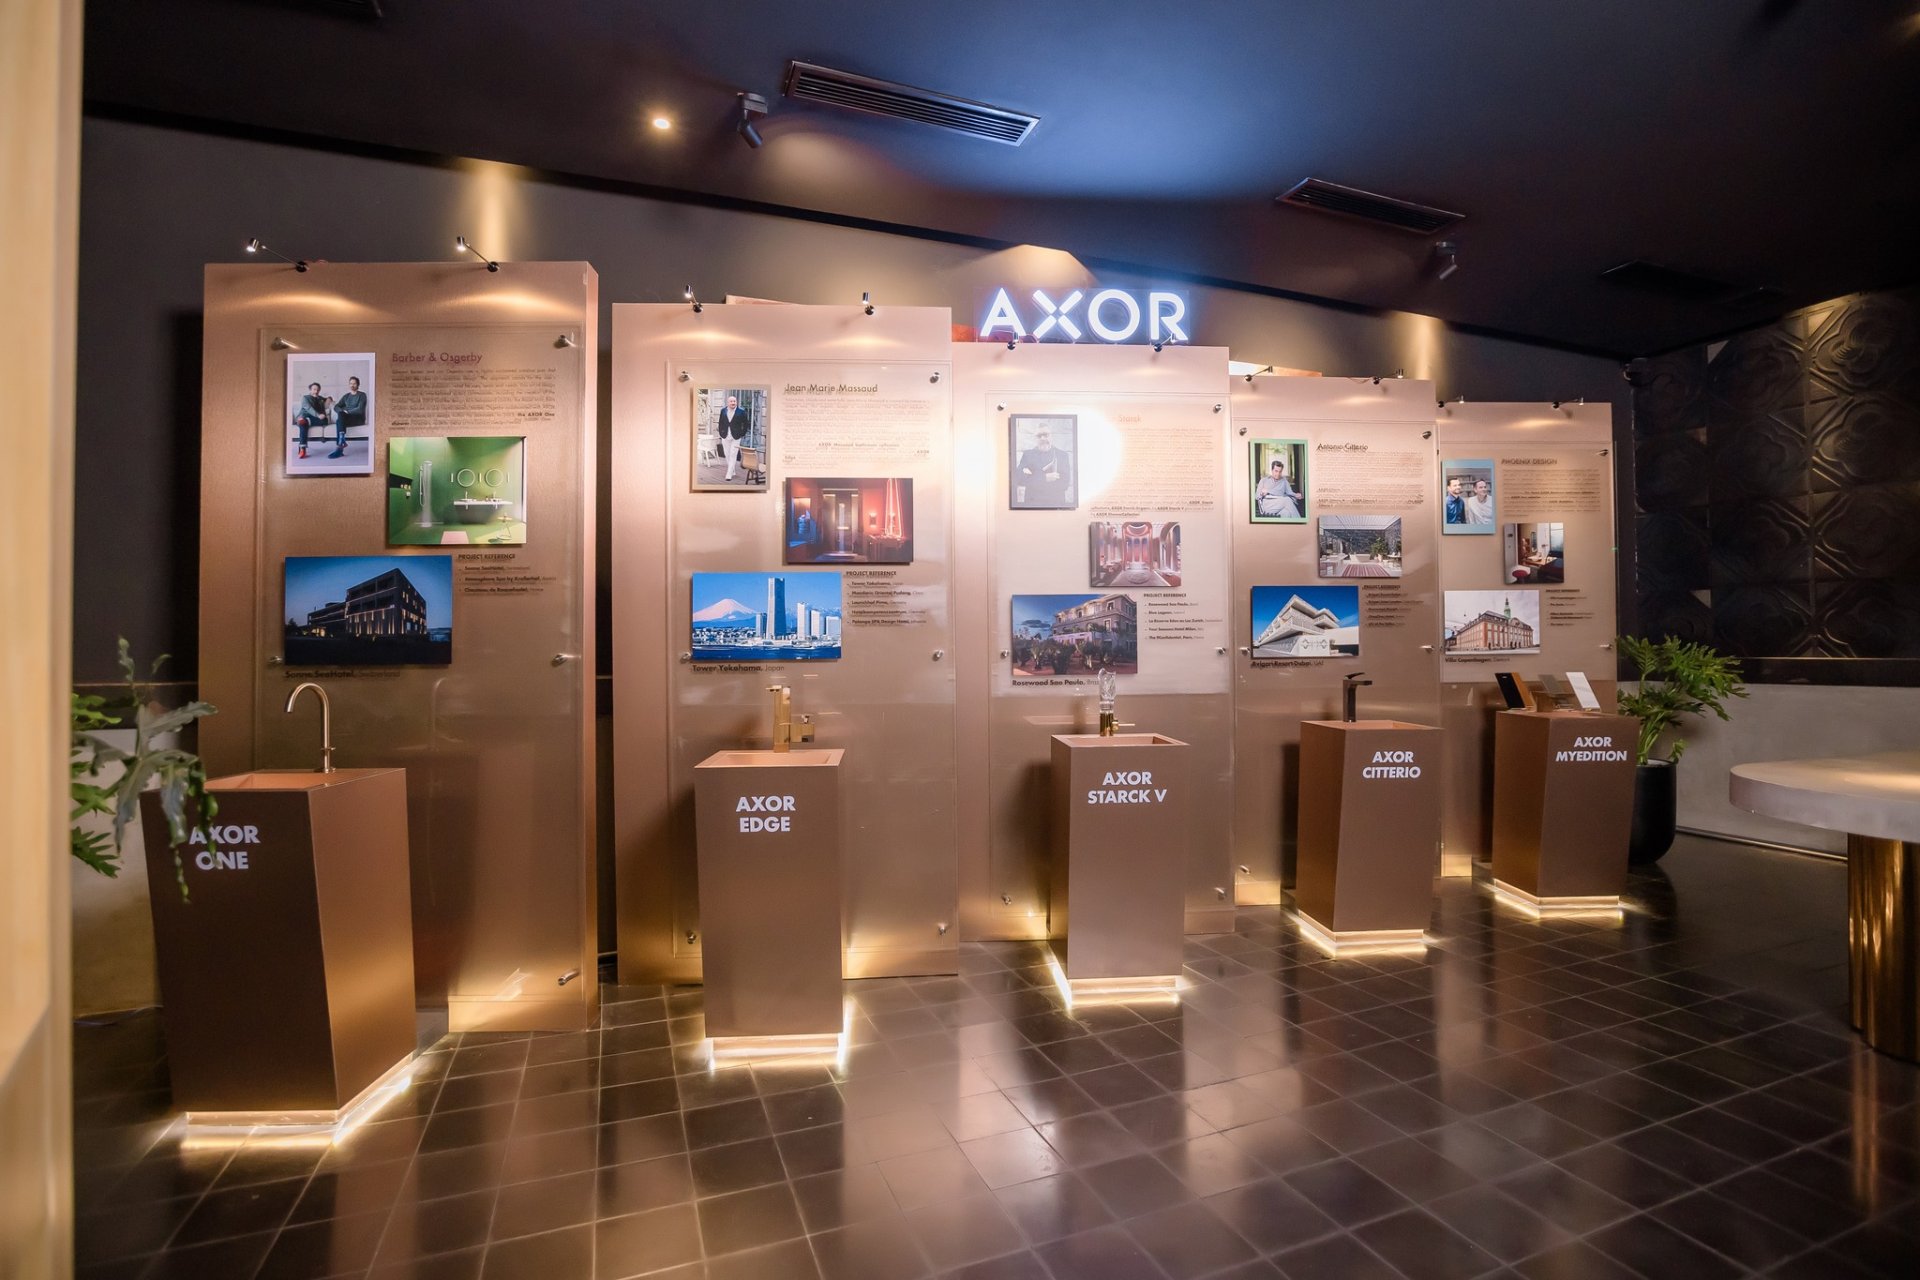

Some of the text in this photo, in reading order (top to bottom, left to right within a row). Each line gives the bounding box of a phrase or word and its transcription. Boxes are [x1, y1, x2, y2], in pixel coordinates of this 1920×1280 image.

[980, 288, 1189, 341] AXOR
[392, 352, 482, 364] Barber & Osgerby
[785, 383, 878, 392] Jean Marie Massaud
[692, 664, 784, 672] Tower Yokohama, Japan
[1574, 737, 1612, 748] AXOR
[1372, 751, 1414, 763] AXOR
[1556, 750, 1628, 762] MYEDITION
[1102, 771, 1152, 786] AXOR
[1362, 766, 1421, 779] CITTERIO
[1088, 789, 1167, 804] STARCK V
[736, 796, 796, 812] AXOR
[740, 816, 791, 832] EDGE
[189, 825, 261, 845] AXOR
[195, 851, 249, 870] ONE
